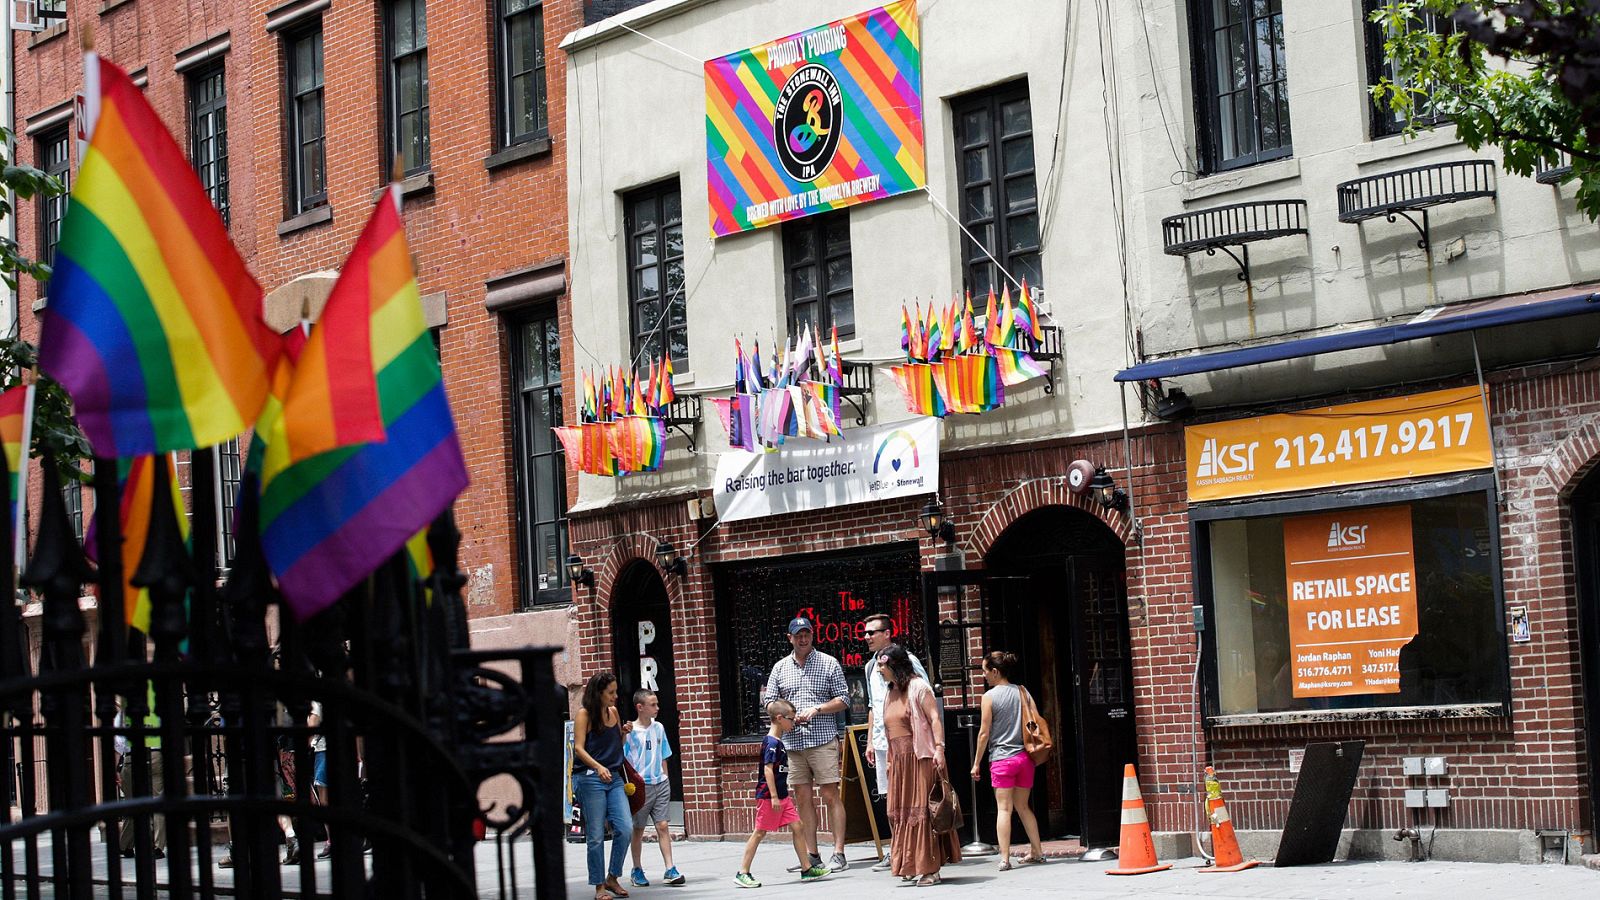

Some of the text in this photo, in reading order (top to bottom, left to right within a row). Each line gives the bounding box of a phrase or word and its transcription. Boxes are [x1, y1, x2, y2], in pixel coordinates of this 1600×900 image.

[767, 24, 847, 70] PROUDLY POURING
[776, 68, 840, 119] THE STONEWALL INN
[802, 164, 816, 178] IPA
[746, 174, 880, 222] BREWED WITH LOVE BY THE BROOKLYN BREWERY
[1273, 412, 1473, 469] 212.417.9217
[725, 460, 856, 493] Raising the bar together.
[1293, 572, 1411, 600] RETAIL SPACE
[838, 591, 865, 611] The
[1307, 605, 1400, 631] FOR LEASE
[1297, 651, 1352, 663] Jordan Raphan
[1368, 648, 1385, 658] Yoni
[1297, 665, 1352, 677] 516.776.4771
